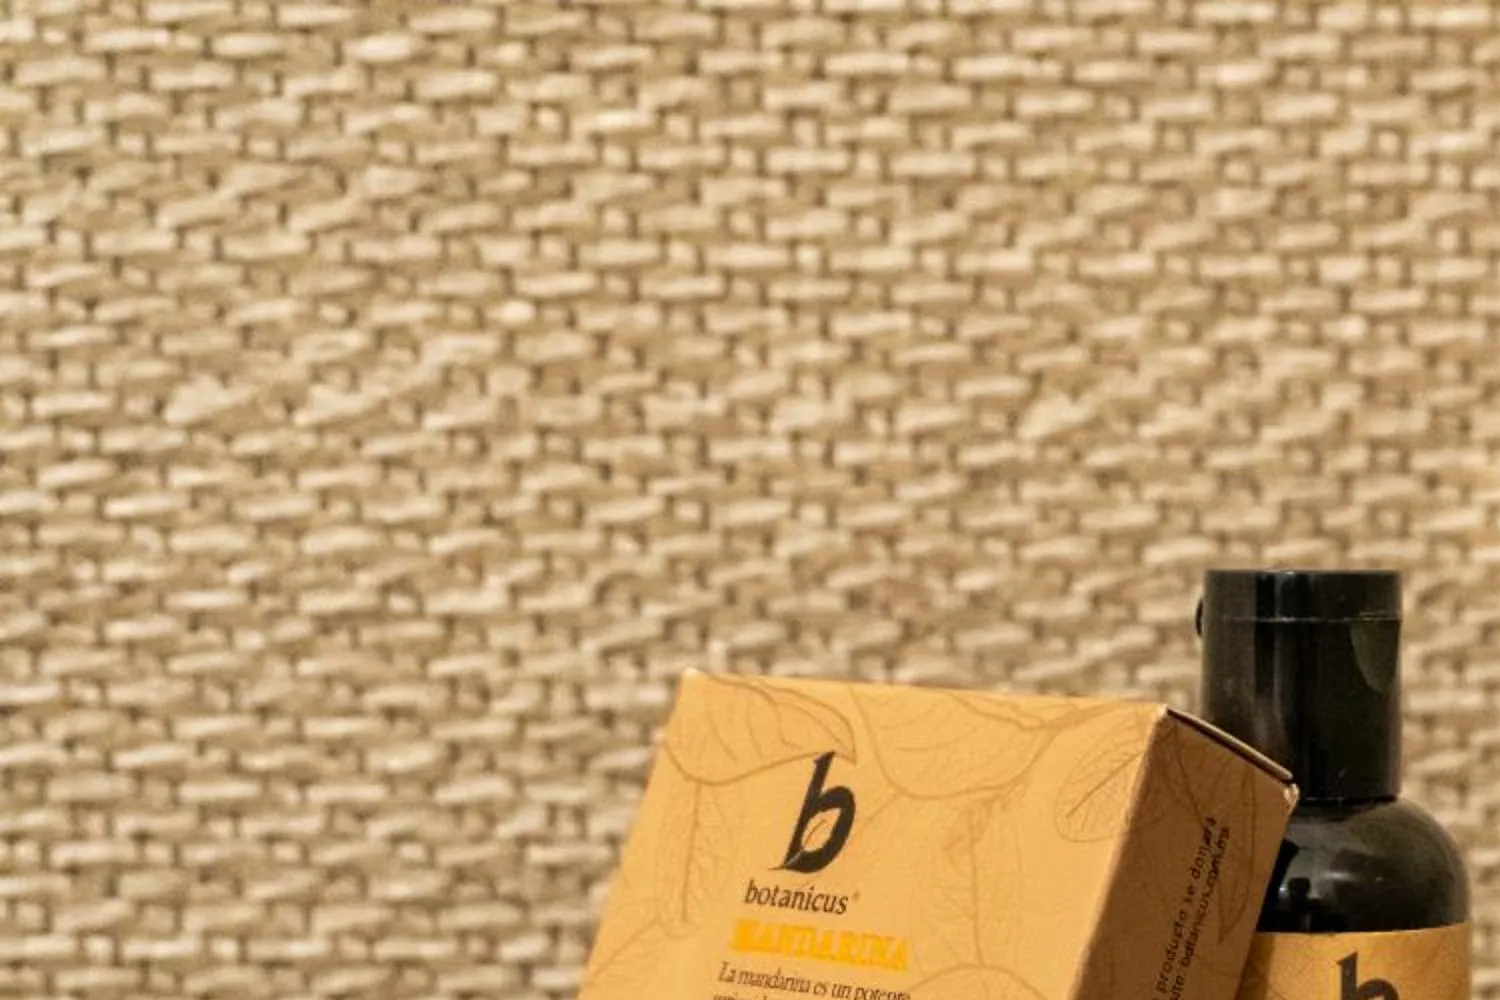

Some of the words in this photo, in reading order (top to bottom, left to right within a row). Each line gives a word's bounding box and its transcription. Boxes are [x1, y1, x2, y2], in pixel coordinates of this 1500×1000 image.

[768, 751, 856, 874] b
[744, 879, 850, 915] botanicus
[731, 918, 909, 972] MANDARINA
[1155, 909, 1188, 994] producto
[717, 961, 736, 983] La
[737, 967, 810, 993] mandarina
[813, 981, 828, 997] es
[831, 982, 851, 999] un
